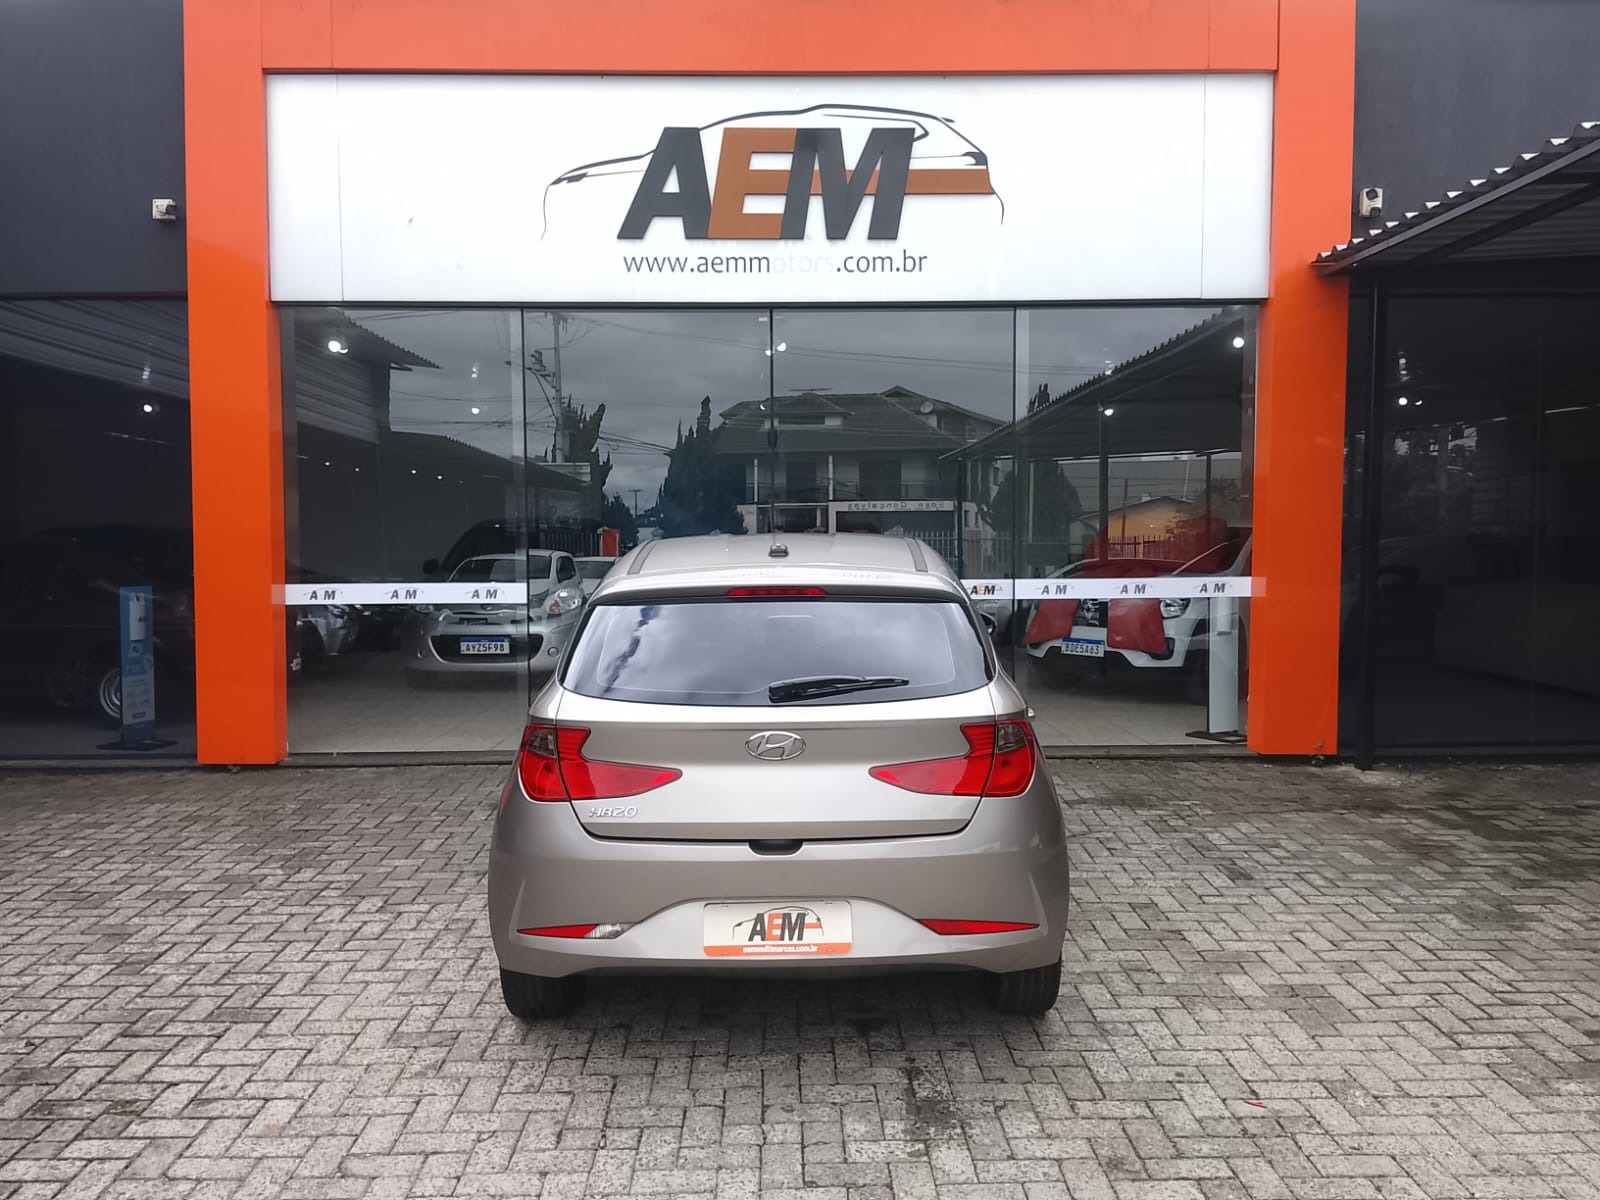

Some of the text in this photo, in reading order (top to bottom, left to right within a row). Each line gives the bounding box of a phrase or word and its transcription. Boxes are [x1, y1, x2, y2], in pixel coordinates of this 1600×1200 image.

[617, 126, 915, 240] AEM
[589, 806, 639, 818] HB20
[748, 912, 806, 941] AEM
